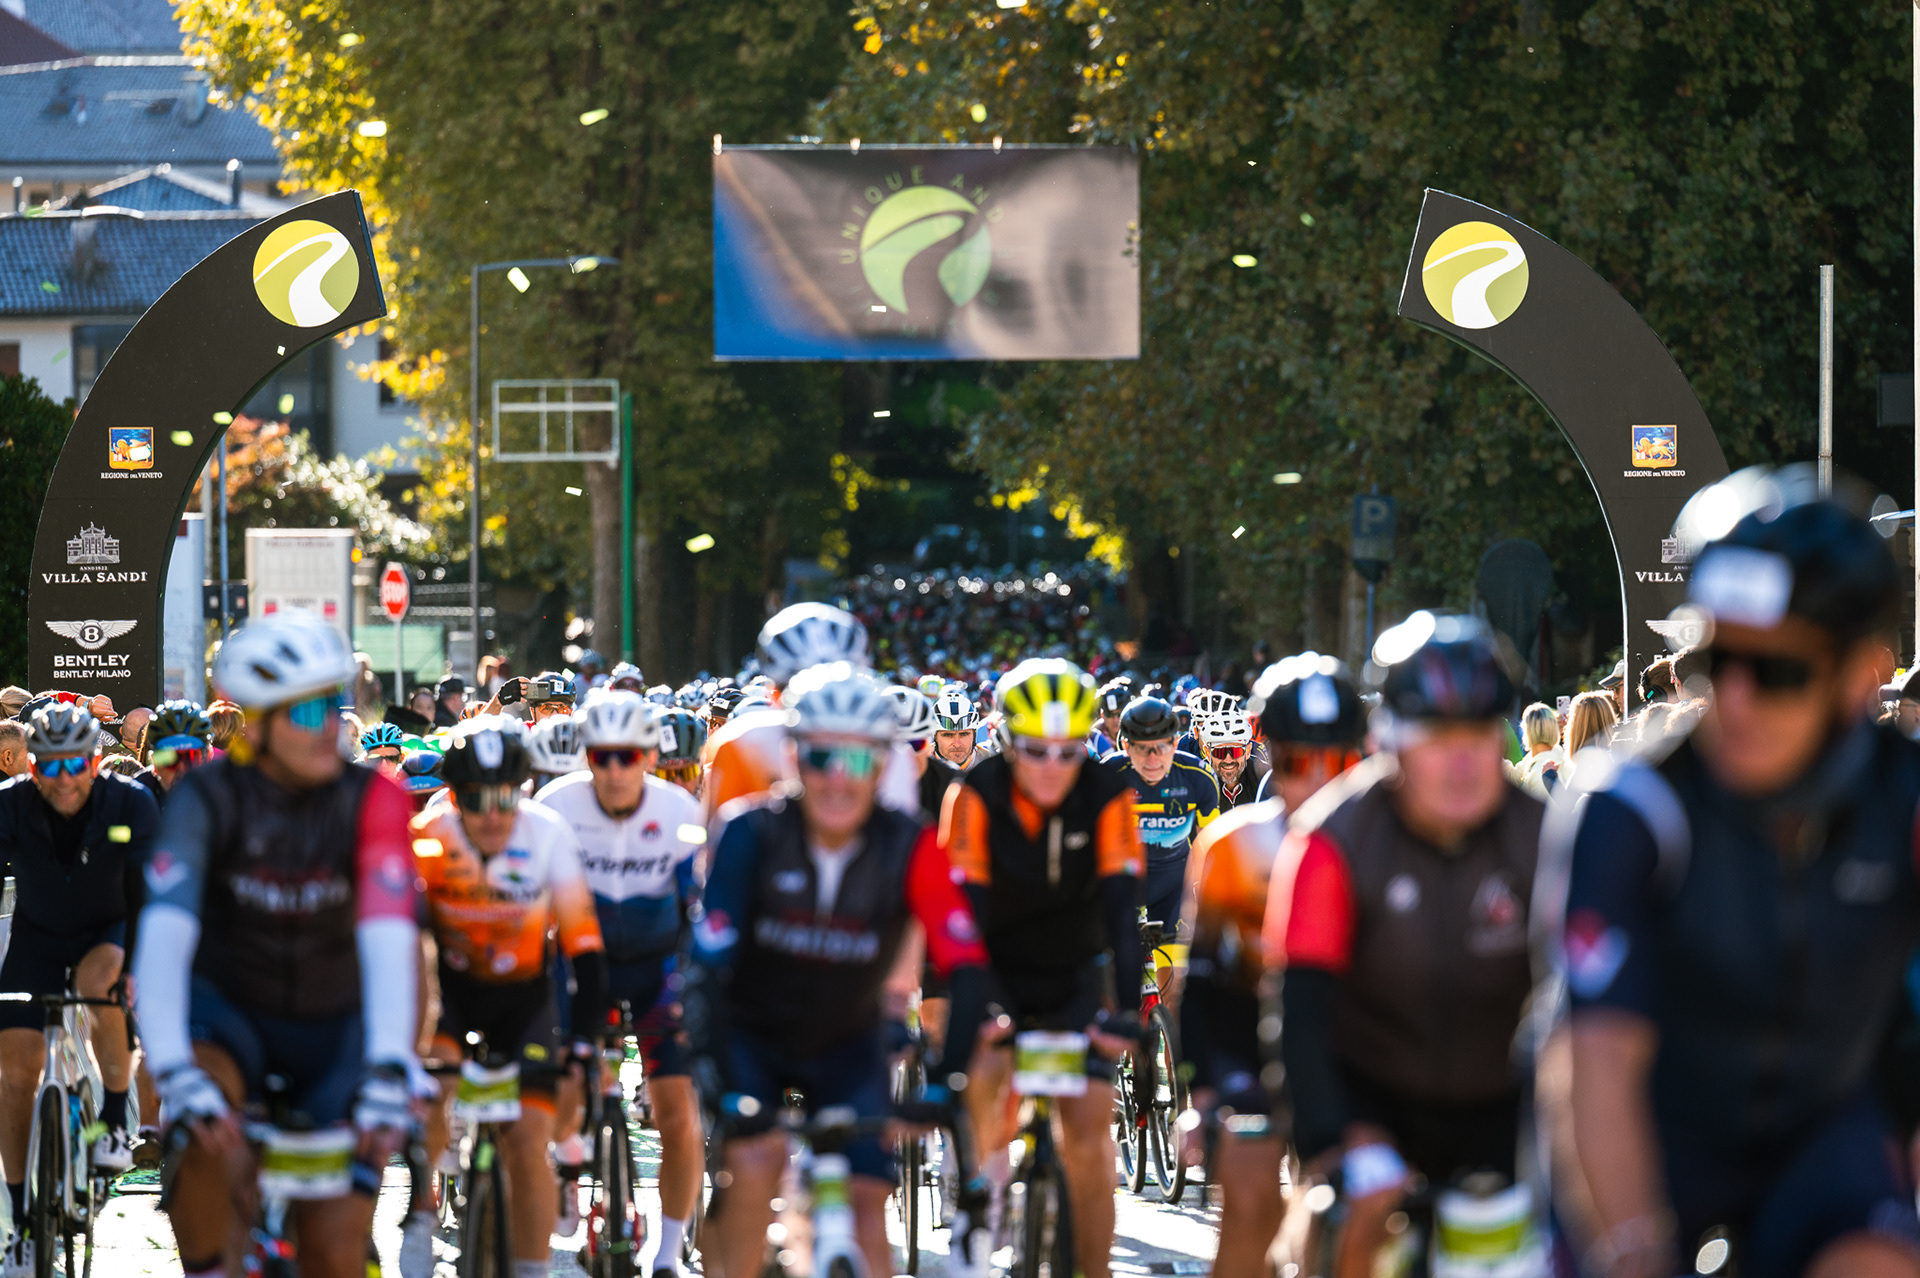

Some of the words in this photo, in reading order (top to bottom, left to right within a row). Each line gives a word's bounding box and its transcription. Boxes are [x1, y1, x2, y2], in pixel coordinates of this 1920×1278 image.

[42, 573, 92, 584] VILLA
[96, 571, 146, 582] SANDI
[1635, 571, 1685, 582] VILLA
[382, 582, 407, 602] STOP
[54, 655, 130, 667] BENTLEY
[54, 670, 95, 678] BENTLEY
[96, 670, 131, 678] MILANO
